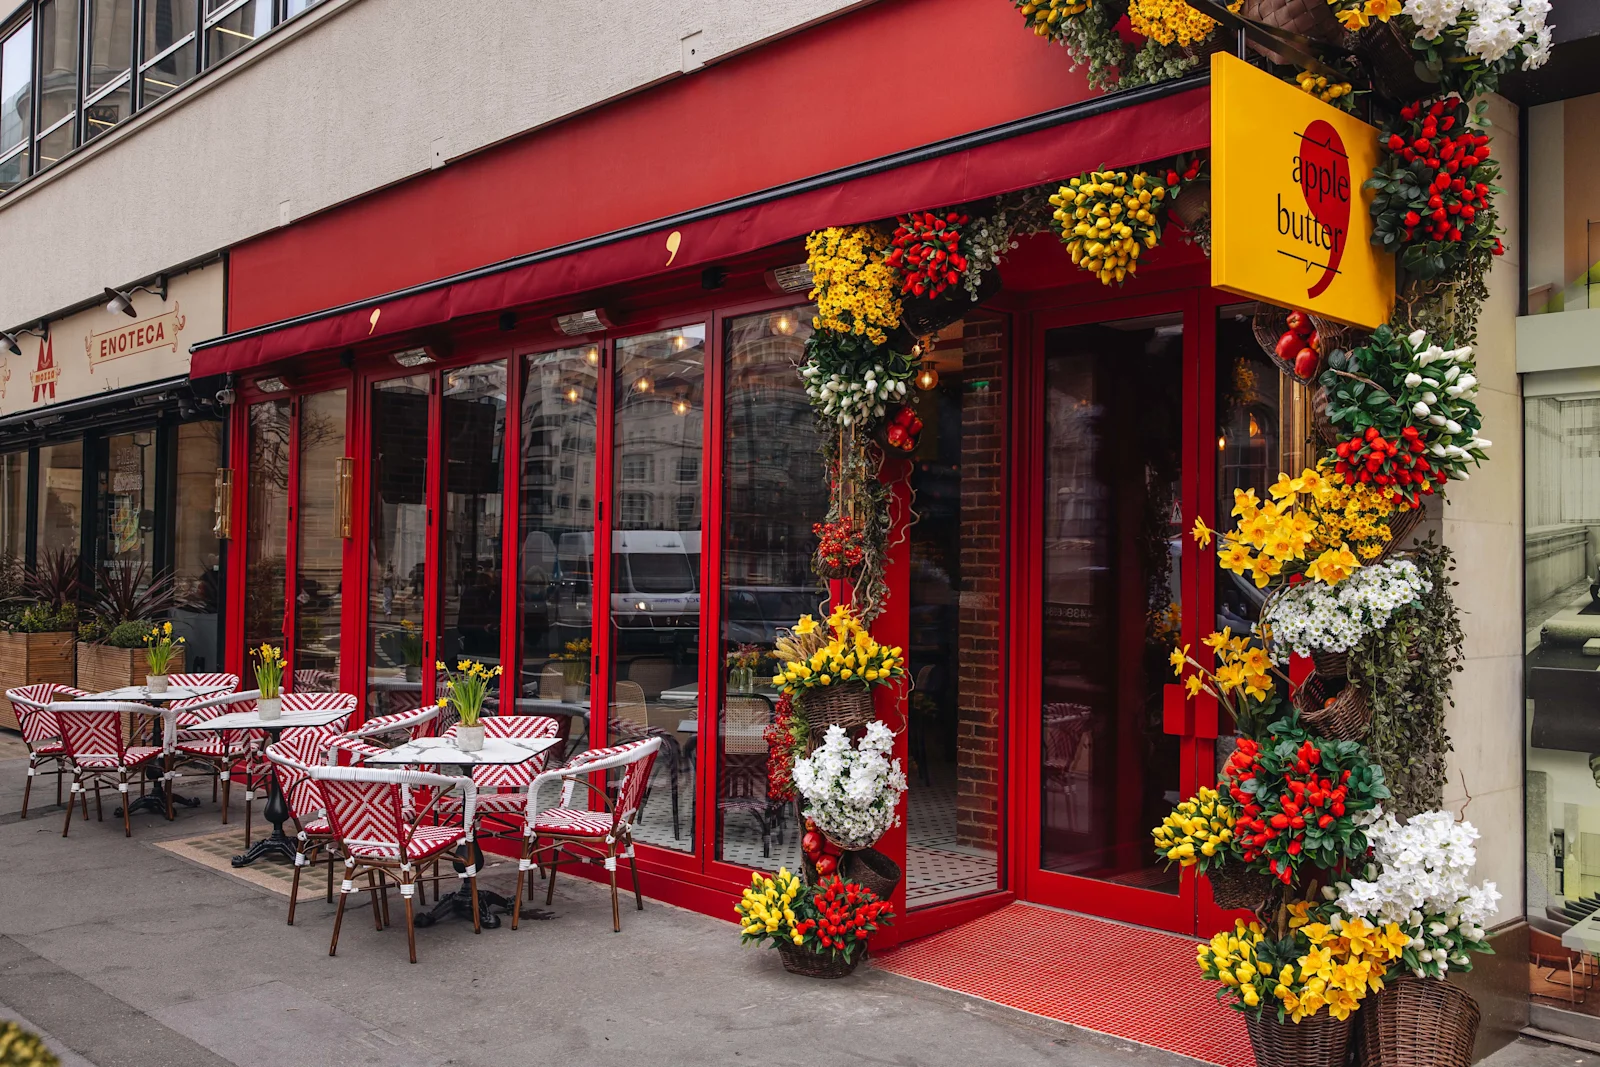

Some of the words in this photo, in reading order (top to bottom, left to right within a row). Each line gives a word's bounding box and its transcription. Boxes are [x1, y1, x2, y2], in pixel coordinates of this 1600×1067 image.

[1292, 156, 1349, 203] apple
[1277, 193, 1342, 252] butter
[100, 321, 165, 358] ENOTECA
